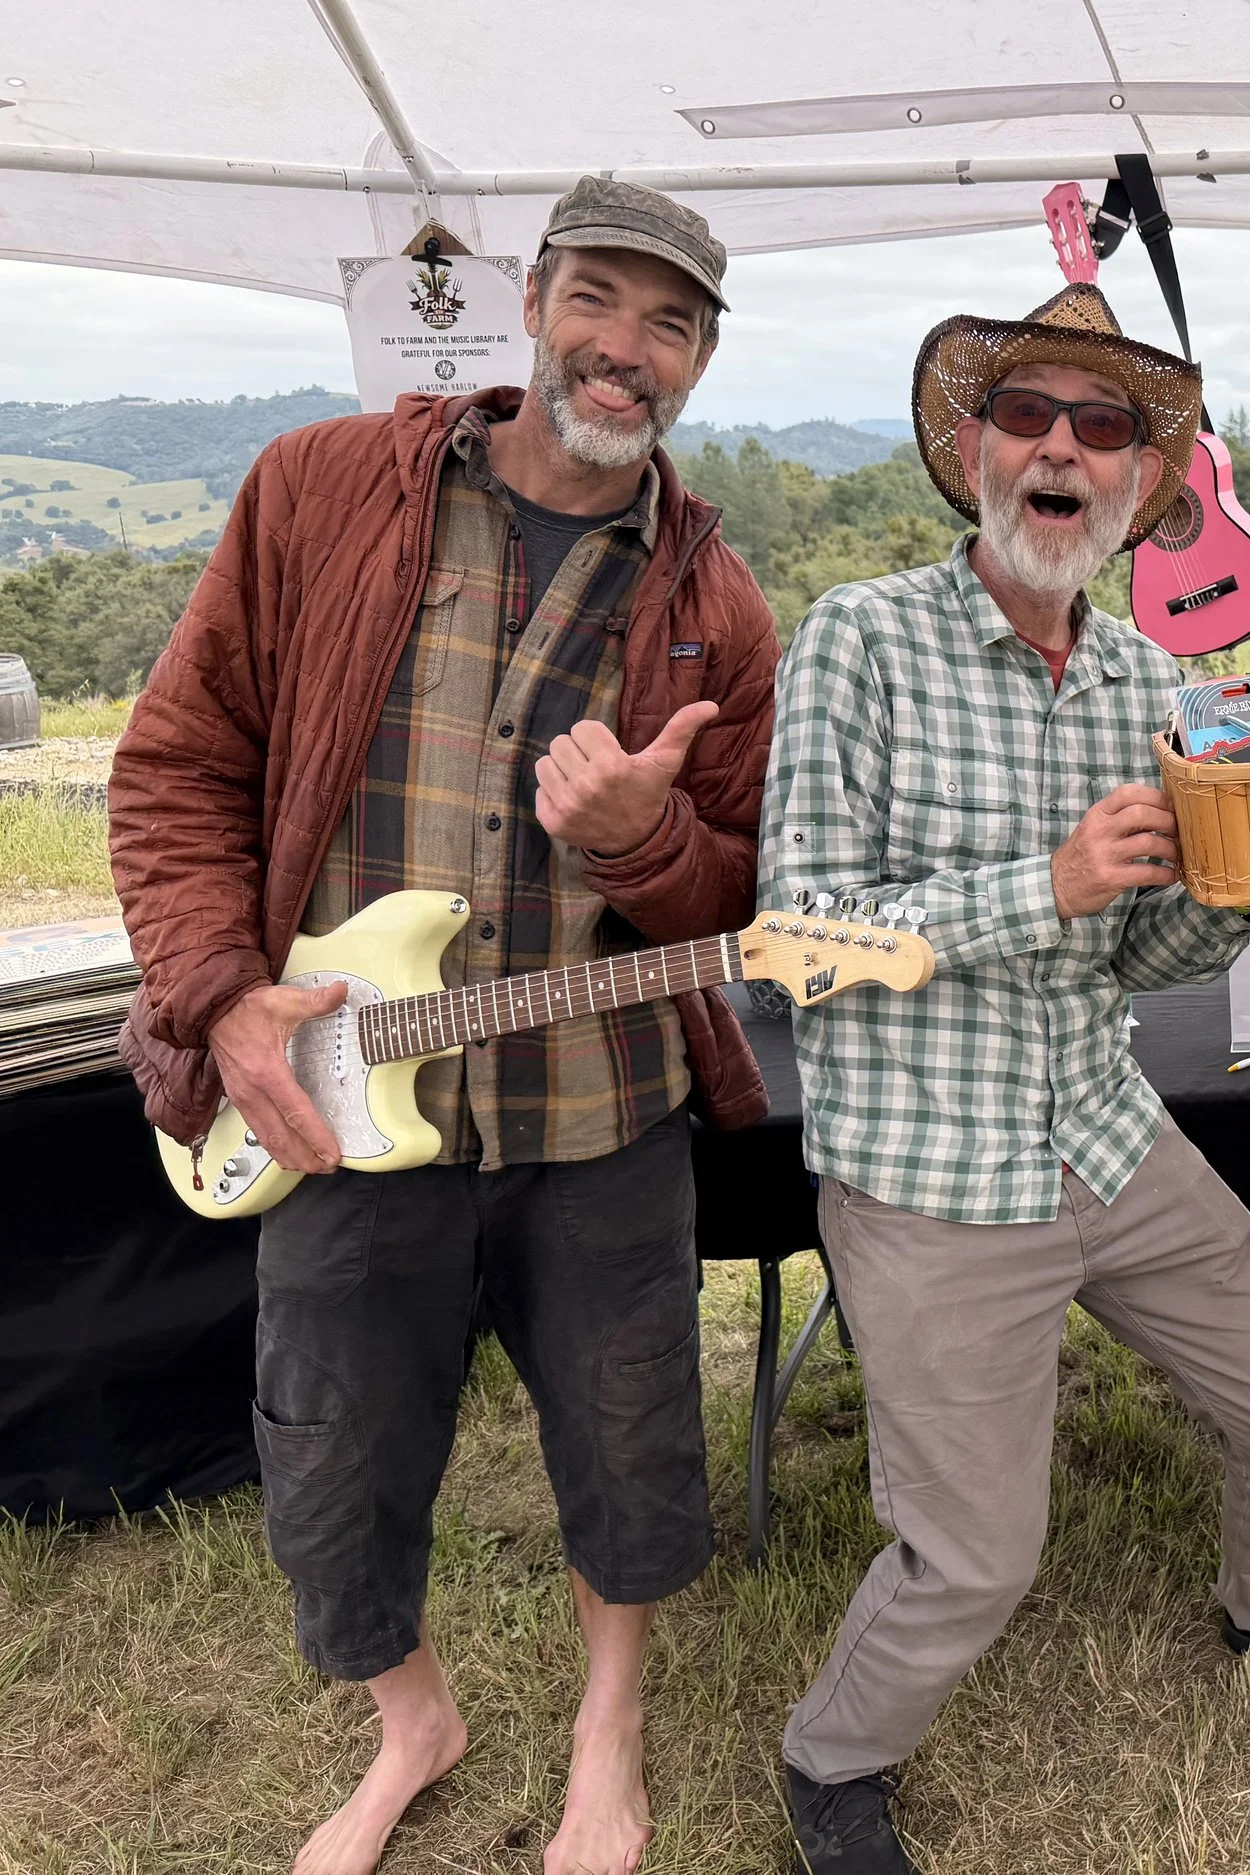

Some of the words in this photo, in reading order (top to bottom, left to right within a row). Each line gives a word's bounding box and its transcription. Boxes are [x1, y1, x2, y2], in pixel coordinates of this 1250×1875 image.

[419, 297, 457, 315] Folk
[427, 315, 453, 323] FARM
[381, 337, 396, 345] FOLK
[397, 337, 405, 345] TO
[406, 336, 423, 344] FARM
[425, 336, 437, 344] AND
[438, 336, 449, 344] THE
[451, 335, 470, 343] MUSIC
[470, 335, 495, 343] LIBRARY
[401, 350, 431, 358] GRATEFUL
[445, 349, 457, 357] OUR
[417, 384, 448, 392] NEWSOME
[1213, 701, 1239, 716] ERNIE
